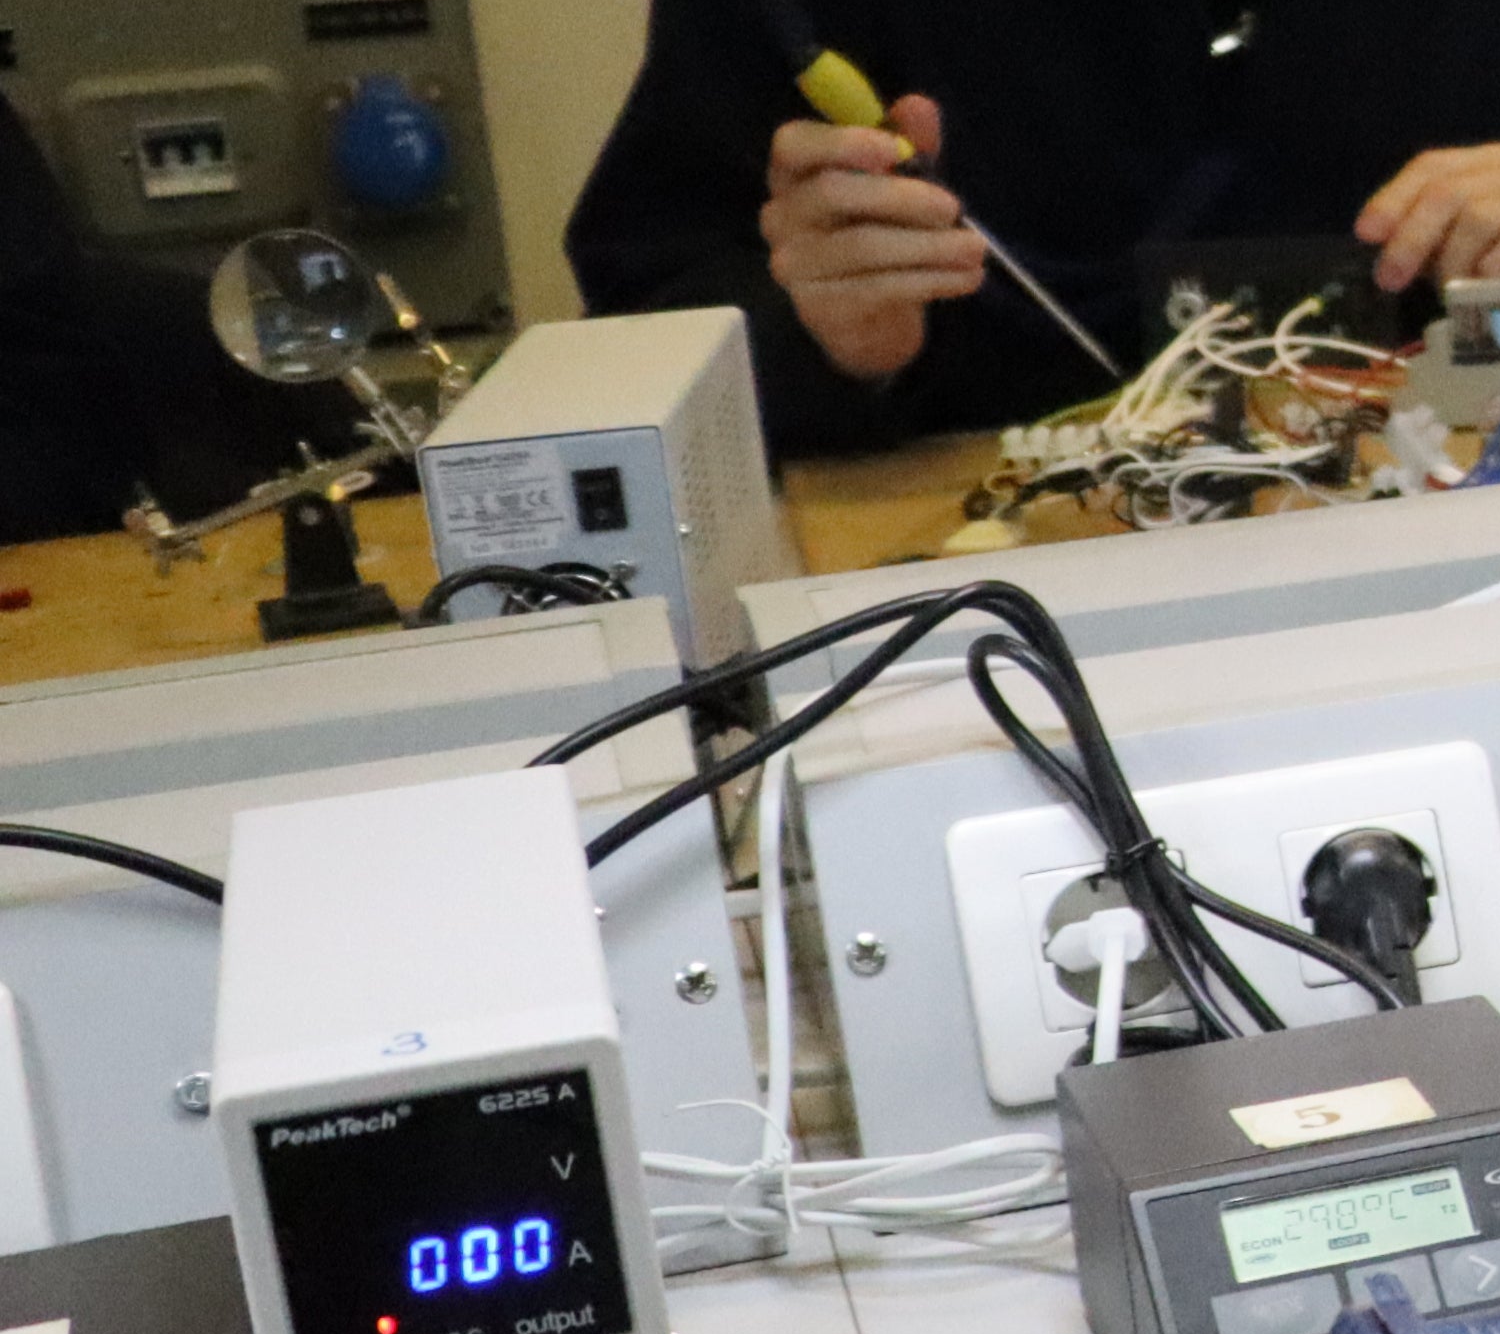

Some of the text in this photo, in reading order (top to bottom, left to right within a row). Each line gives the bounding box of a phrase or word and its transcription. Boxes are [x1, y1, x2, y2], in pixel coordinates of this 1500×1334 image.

[478, 1082, 575, 1114] 6225 A
[1293, 1104, 1342, 1130] 5
[550, 1152, 575, 1181] V
[409, 1217, 551, 1294] 000
[568, 1239, 592, 1267] A
[1240, 1236, 1283, 1253] ECON
